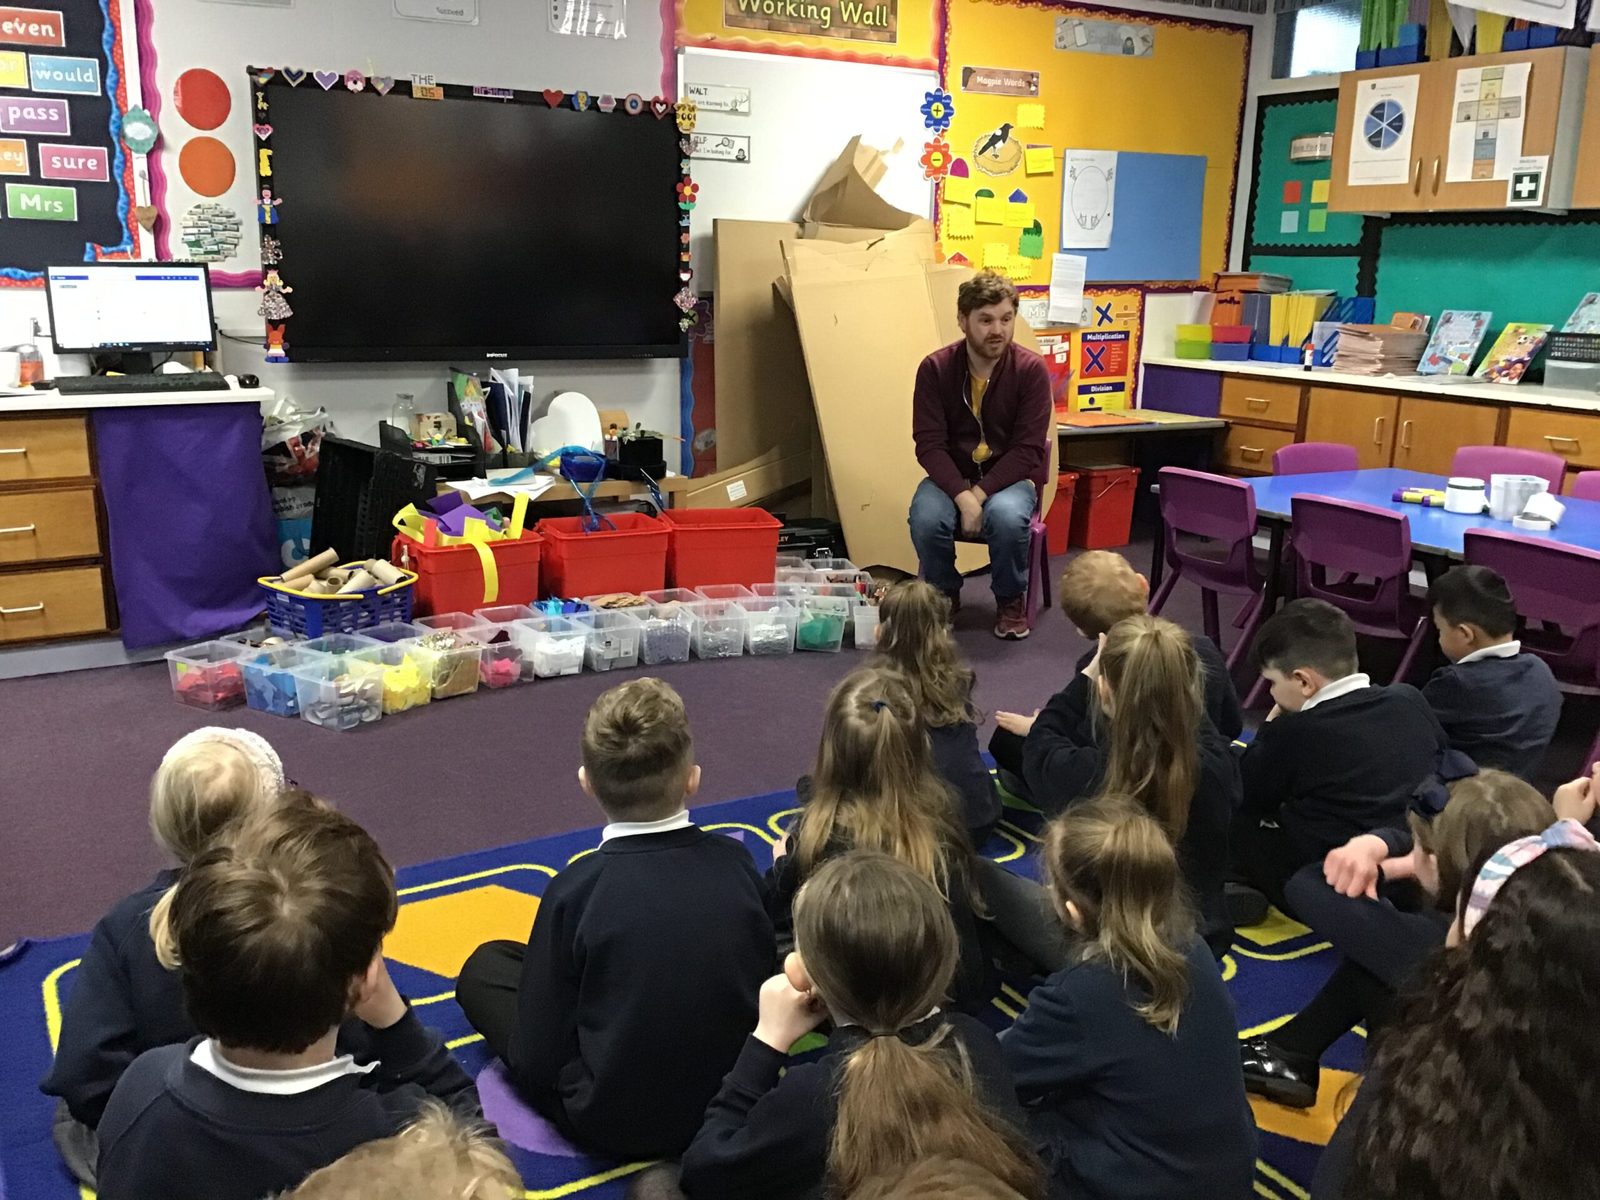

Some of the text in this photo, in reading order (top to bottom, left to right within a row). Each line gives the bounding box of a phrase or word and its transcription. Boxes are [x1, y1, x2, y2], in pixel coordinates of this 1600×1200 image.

[738, 0, 888, 29] Working Wall
[2, 21, 55, 38] even
[35, 67, 95, 84] would
[411, 73, 435, 86] THE
[976, 75, 1026, 88] Magpie Words
[689, 86, 708, 96] WALT
[8, 106, 60, 126] pass
[0, 151, 24, 167] ey
[51, 155, 98, 170] sure
[20, 192, 64, 213] Mrs
[1086, 332, 1125, 342] Multiplication
[1090, 384, 1113, 393] Division
